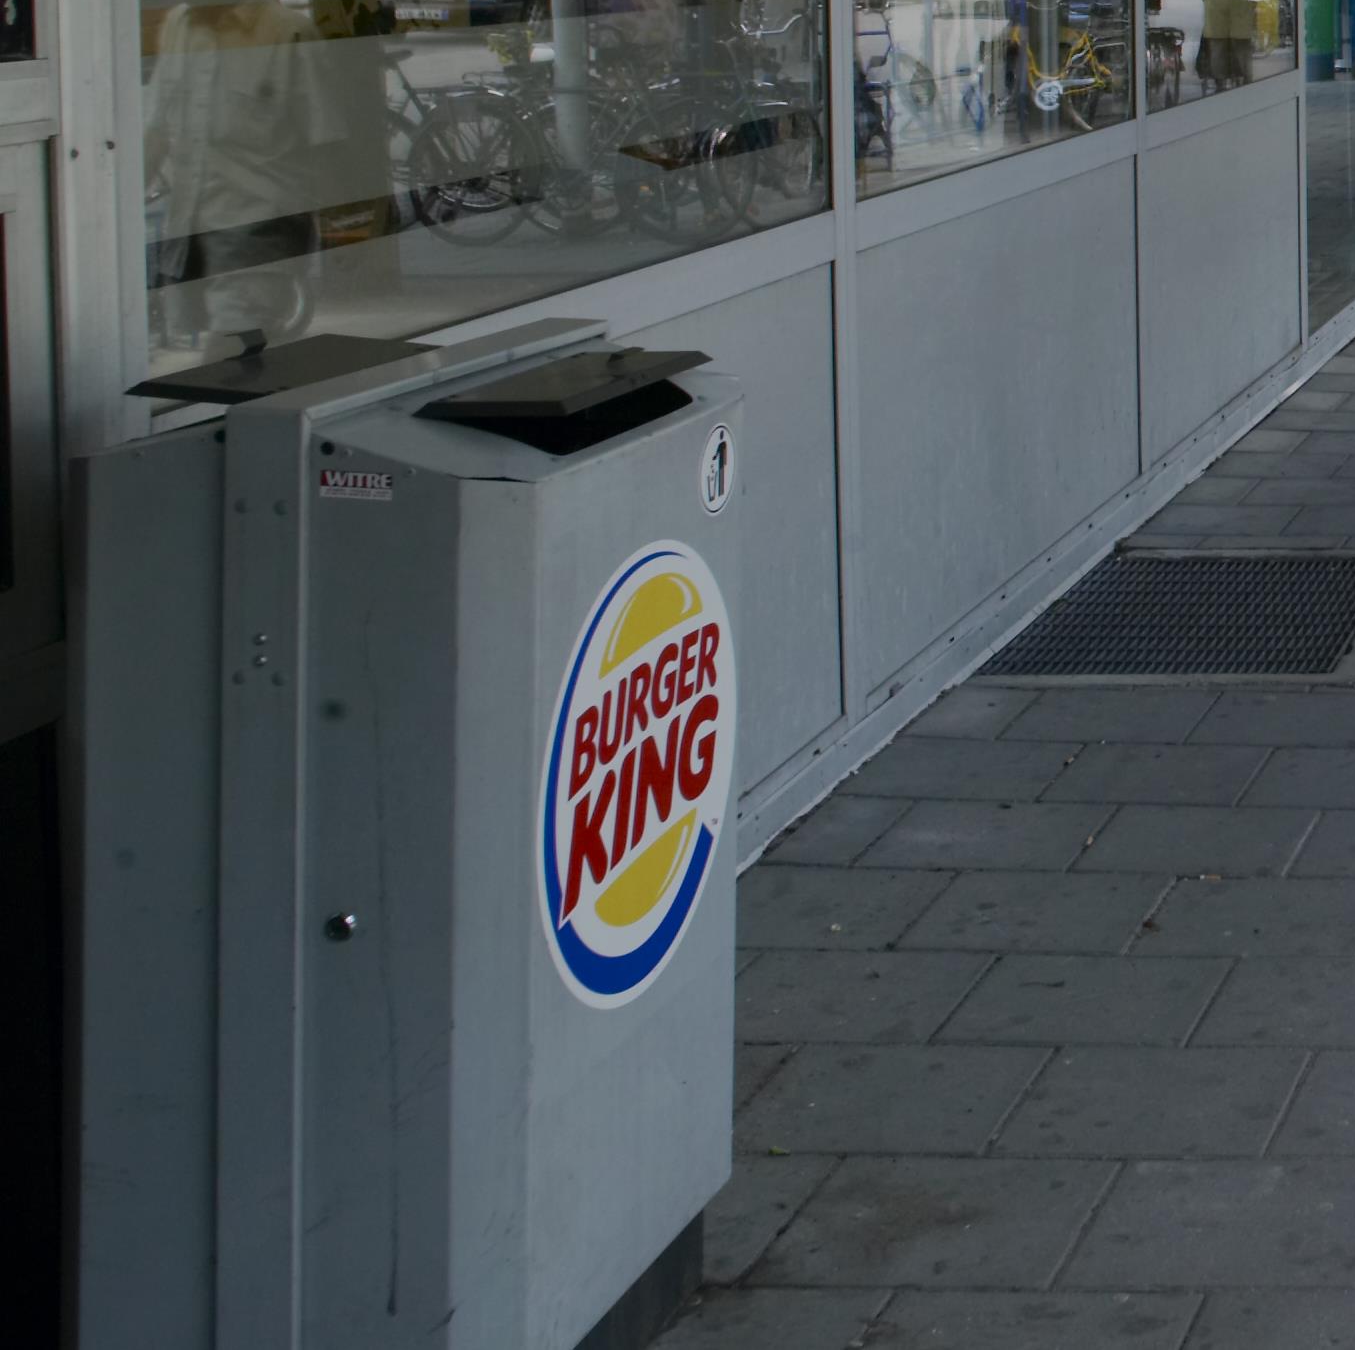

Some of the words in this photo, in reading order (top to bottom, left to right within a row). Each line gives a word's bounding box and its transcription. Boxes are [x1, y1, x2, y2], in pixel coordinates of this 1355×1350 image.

[325, 470, 392, 489] WITRE
[569, 622, 720, 801] BURGER
[561, 694, 719, 922] KING
